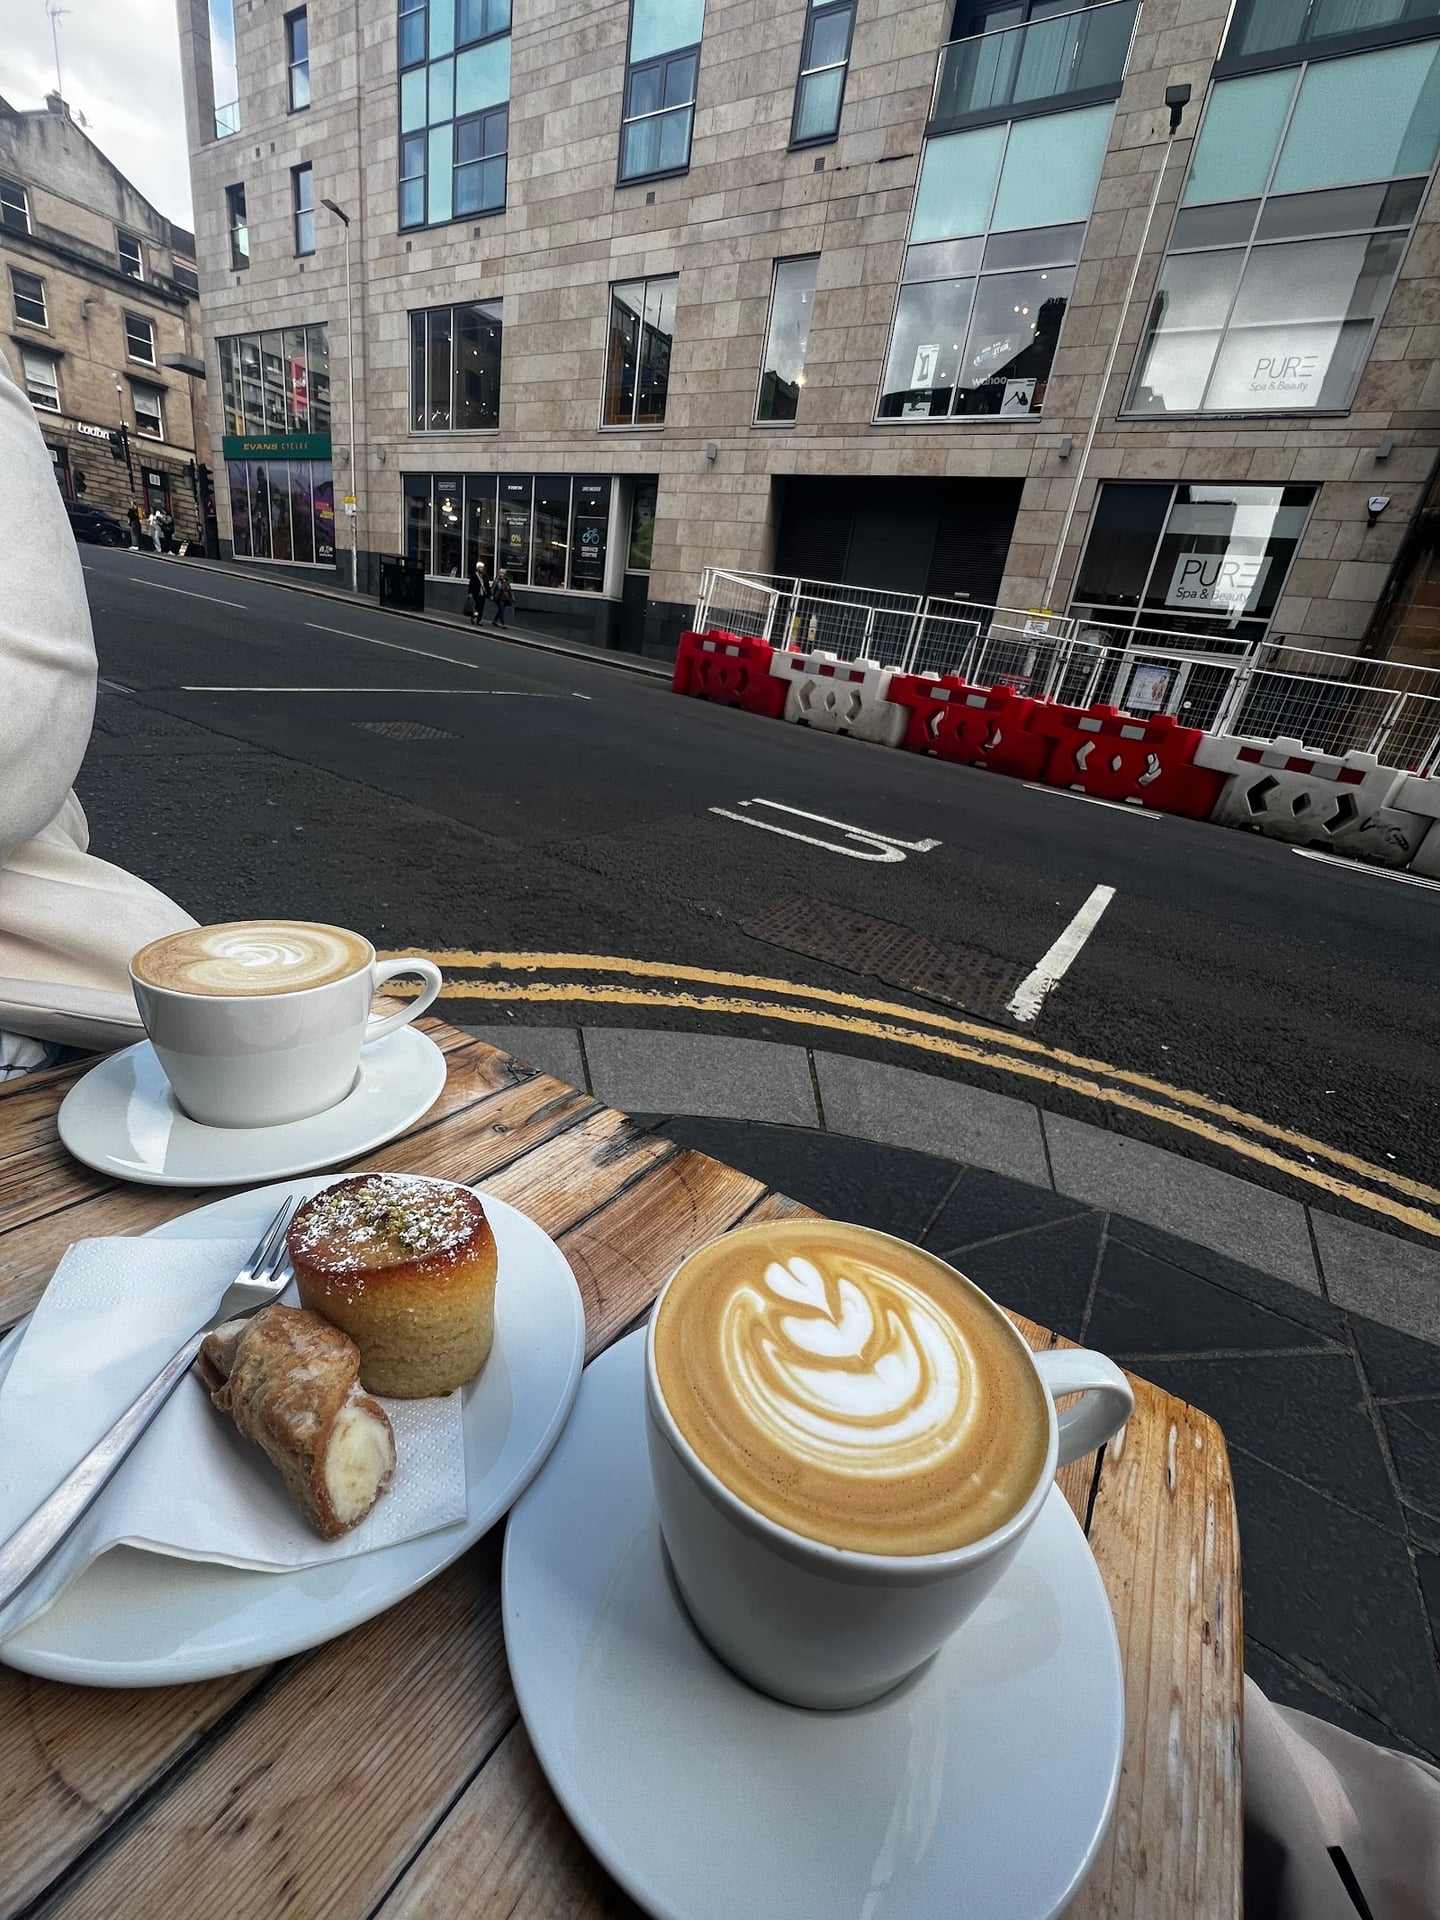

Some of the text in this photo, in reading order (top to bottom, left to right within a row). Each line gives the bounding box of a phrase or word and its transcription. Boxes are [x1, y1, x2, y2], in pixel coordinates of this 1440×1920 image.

[1253, 355, 1318, 379] PURE
[1249, 381, 1308, 392] Spa & Beauty
[243, 443, 278, 451] EVANS
[1180, 559, 1261, 587] PURE
[1176, 587, 1247, 605] Spa & Beauty
